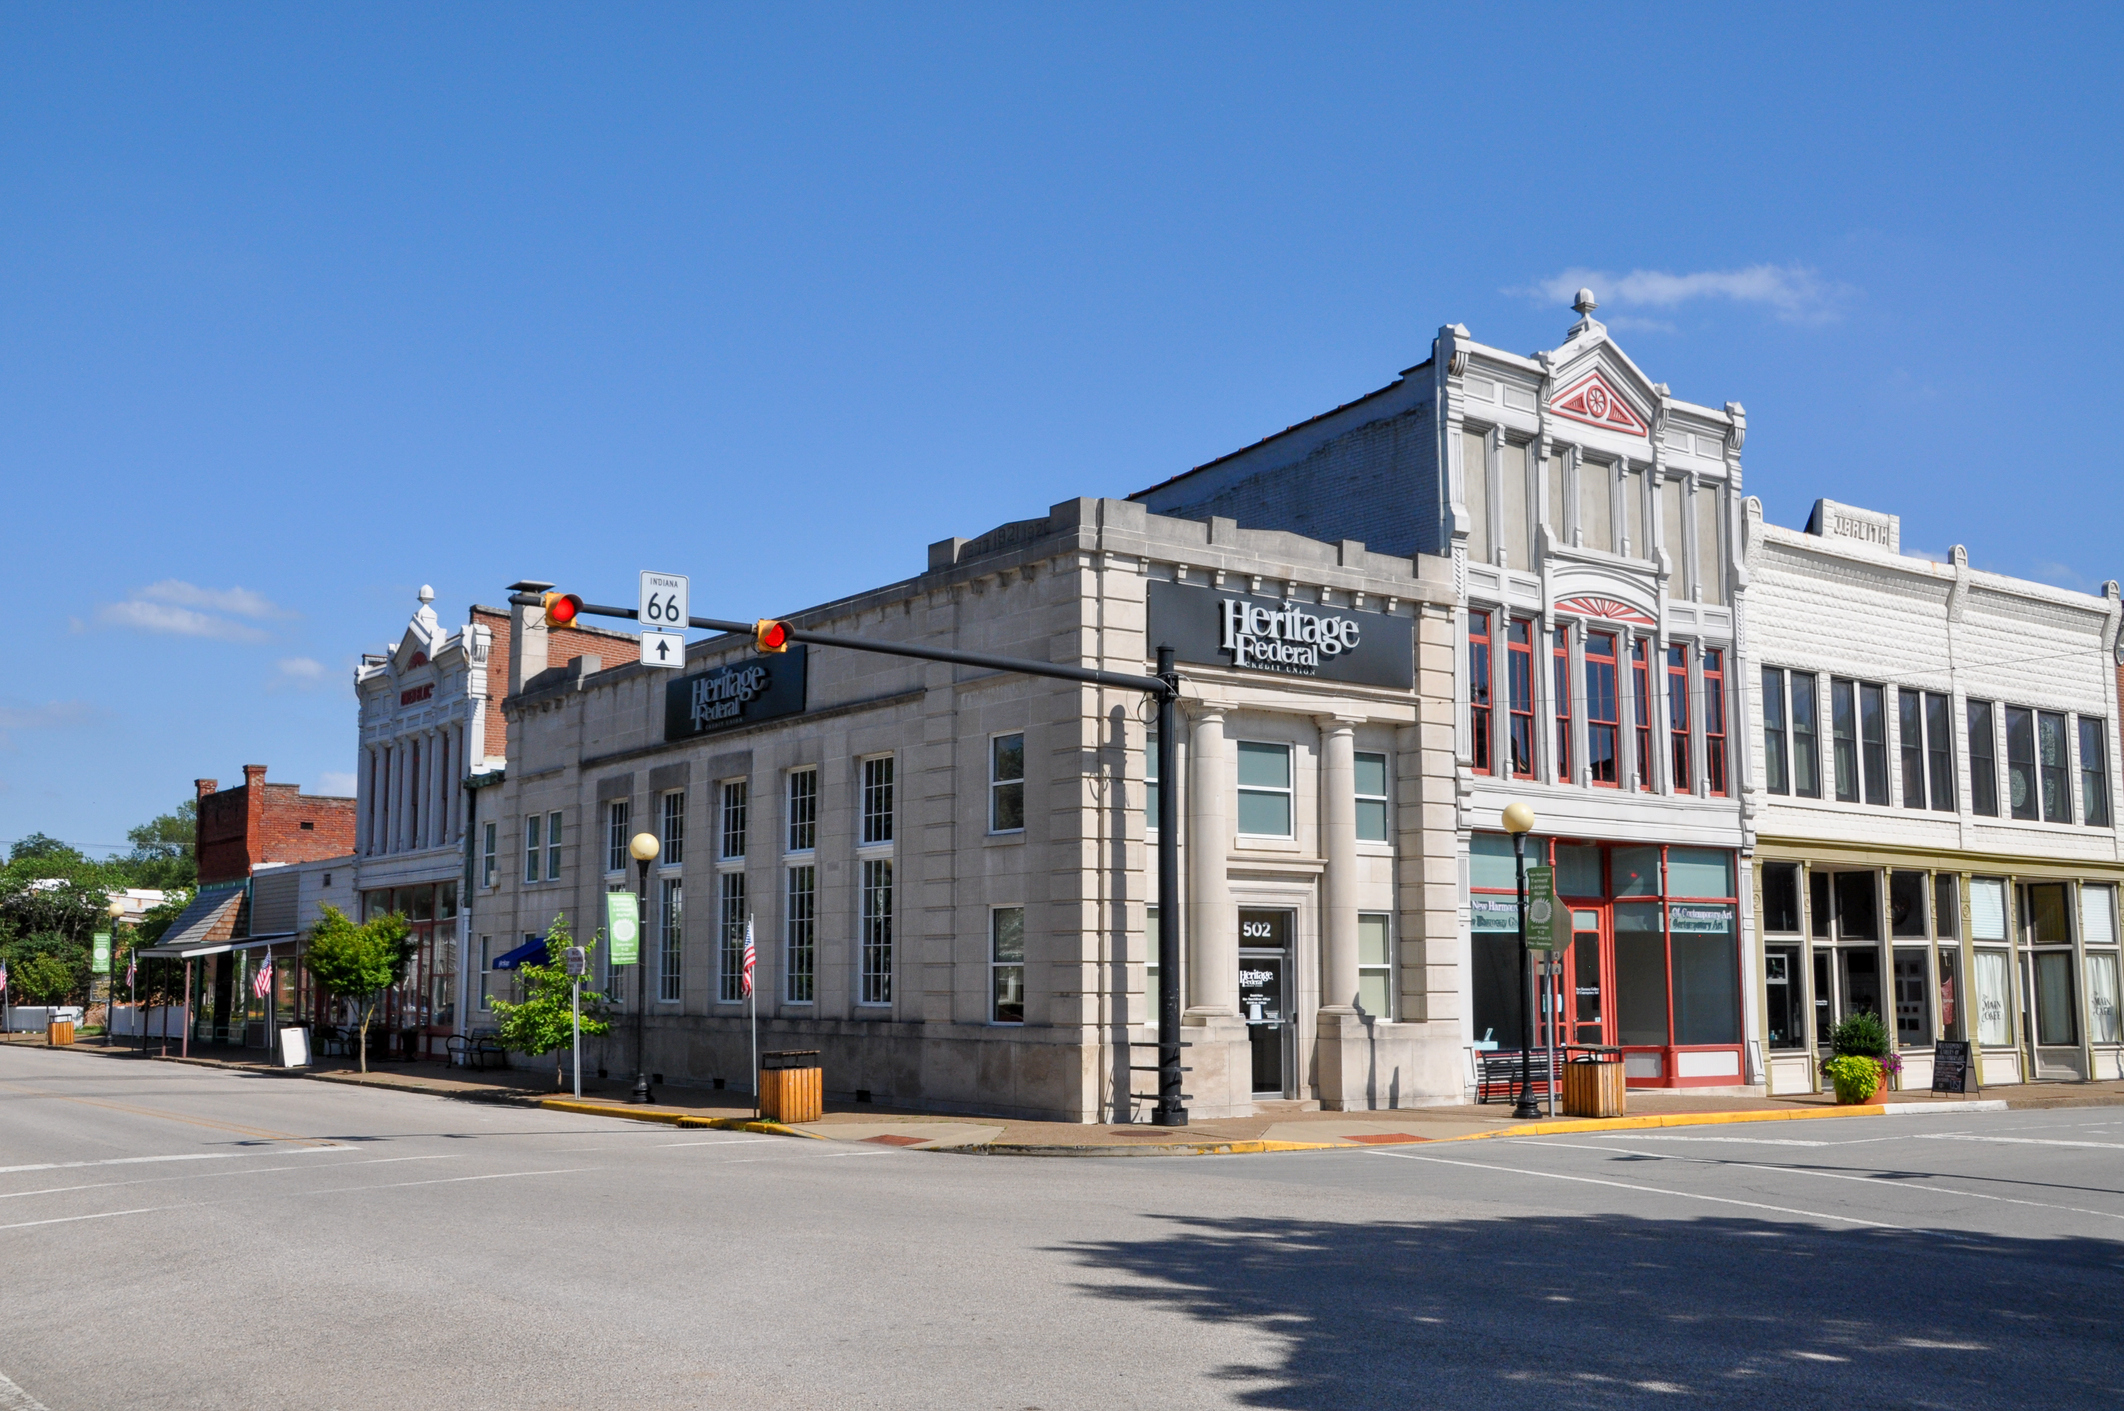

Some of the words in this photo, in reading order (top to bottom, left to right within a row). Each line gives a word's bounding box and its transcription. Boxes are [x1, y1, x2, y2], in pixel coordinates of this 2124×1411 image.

[993, 524, 1019, 547] 1921
[650, 577, 678, 588] INDIANA
[648, 592, 679, 622] 66
[1222, 598, 1360, 655] Heritage
[1234, 632, 1319, 667] Federal
[1245, 660, 1281, 672] CREDIT
[1286, 666, 1316, 676] UNION
[690, 666, 765, 719] Heritage
[694, 699, 741, 731] Federal
[705, 721, 724, 730] CREDIT
[725, 717, 743, 726] UNION
[1472, 900, 1488, 910] New
[1682, 907, 1721, 920] Contemporary
[1721, 909, 1733, 920] Art
[1243, 922, 1271, 937] 502
[1239, 969, 1274, 983] Heritage
[1242, 978, 1263, 987] Federal
[1982, 1000, 2002, 1010] MAIN
[2092, 997, 2111, 1006] MAIN
[2093, 1006, 2111, 1016] CAFE
